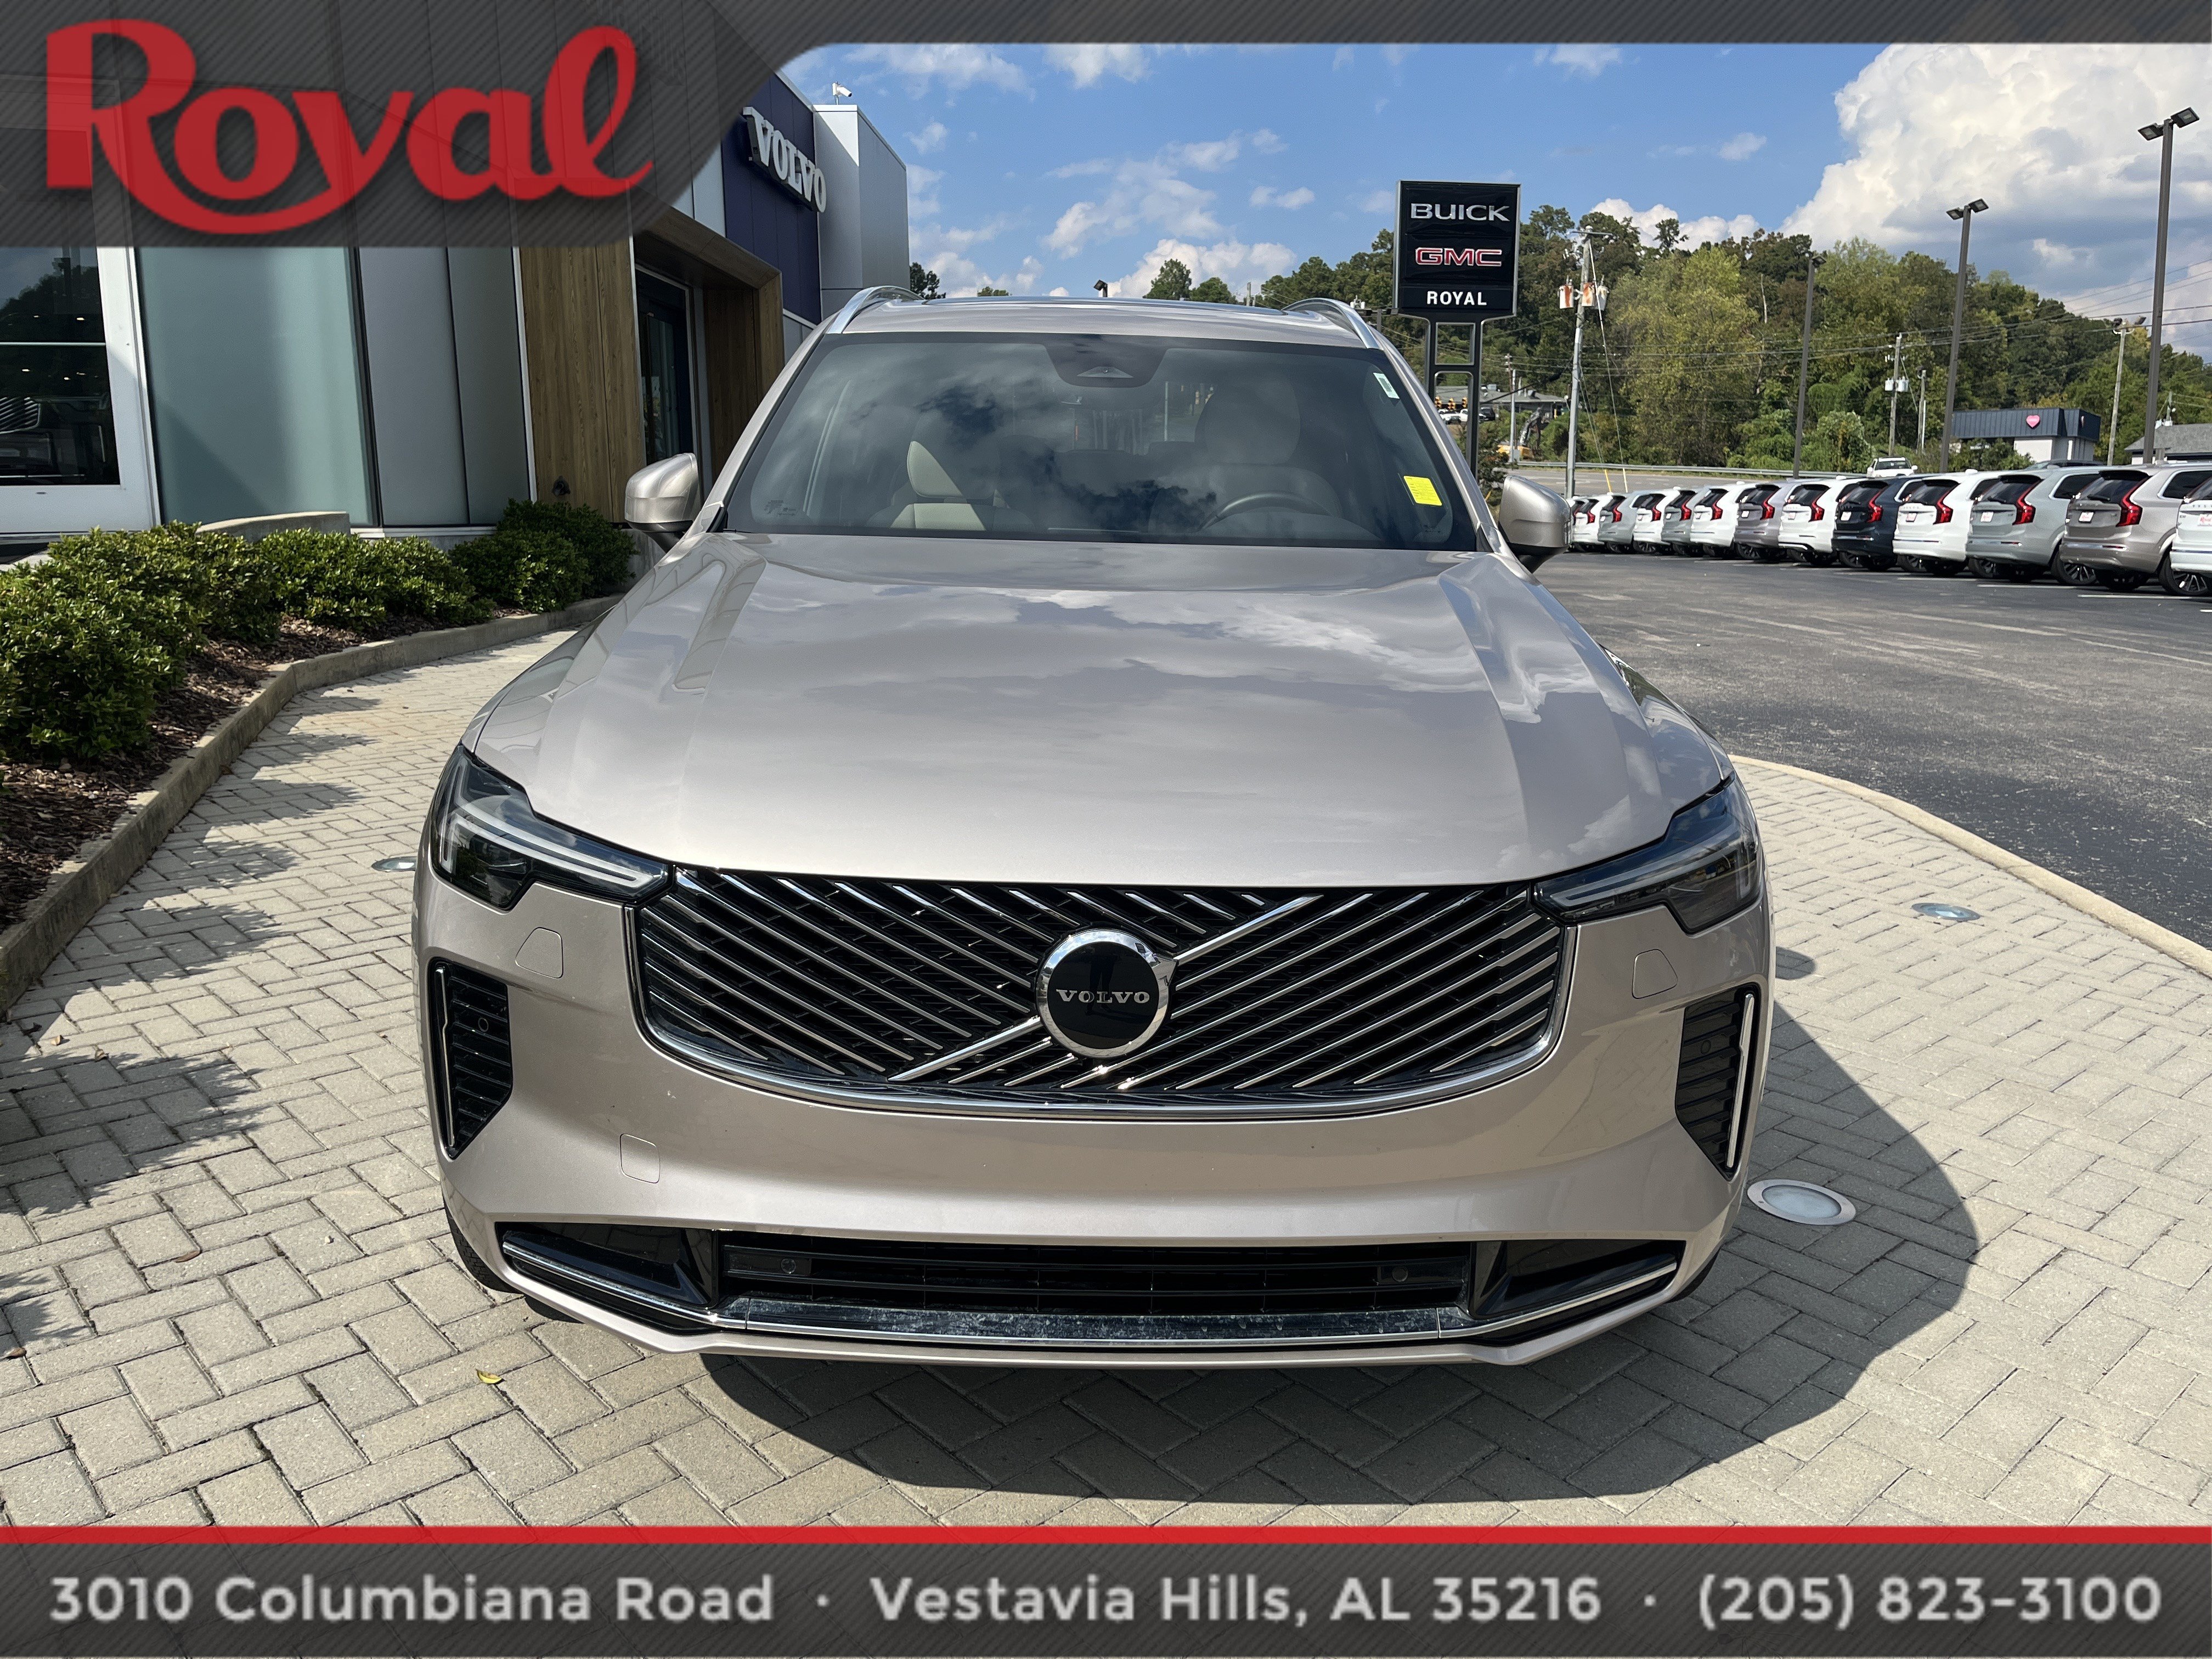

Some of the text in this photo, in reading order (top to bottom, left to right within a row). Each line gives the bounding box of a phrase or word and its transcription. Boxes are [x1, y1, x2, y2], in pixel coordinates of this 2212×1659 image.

[742, 106, 827, 213] VOLVO
[1410, 202, 1510, 222] BUICK
[1415, 247, 1503, 267] GMC
[1426, 291, 1487, 306] ROYAL
[1056, 989, 1150, 1004] VOLVO
